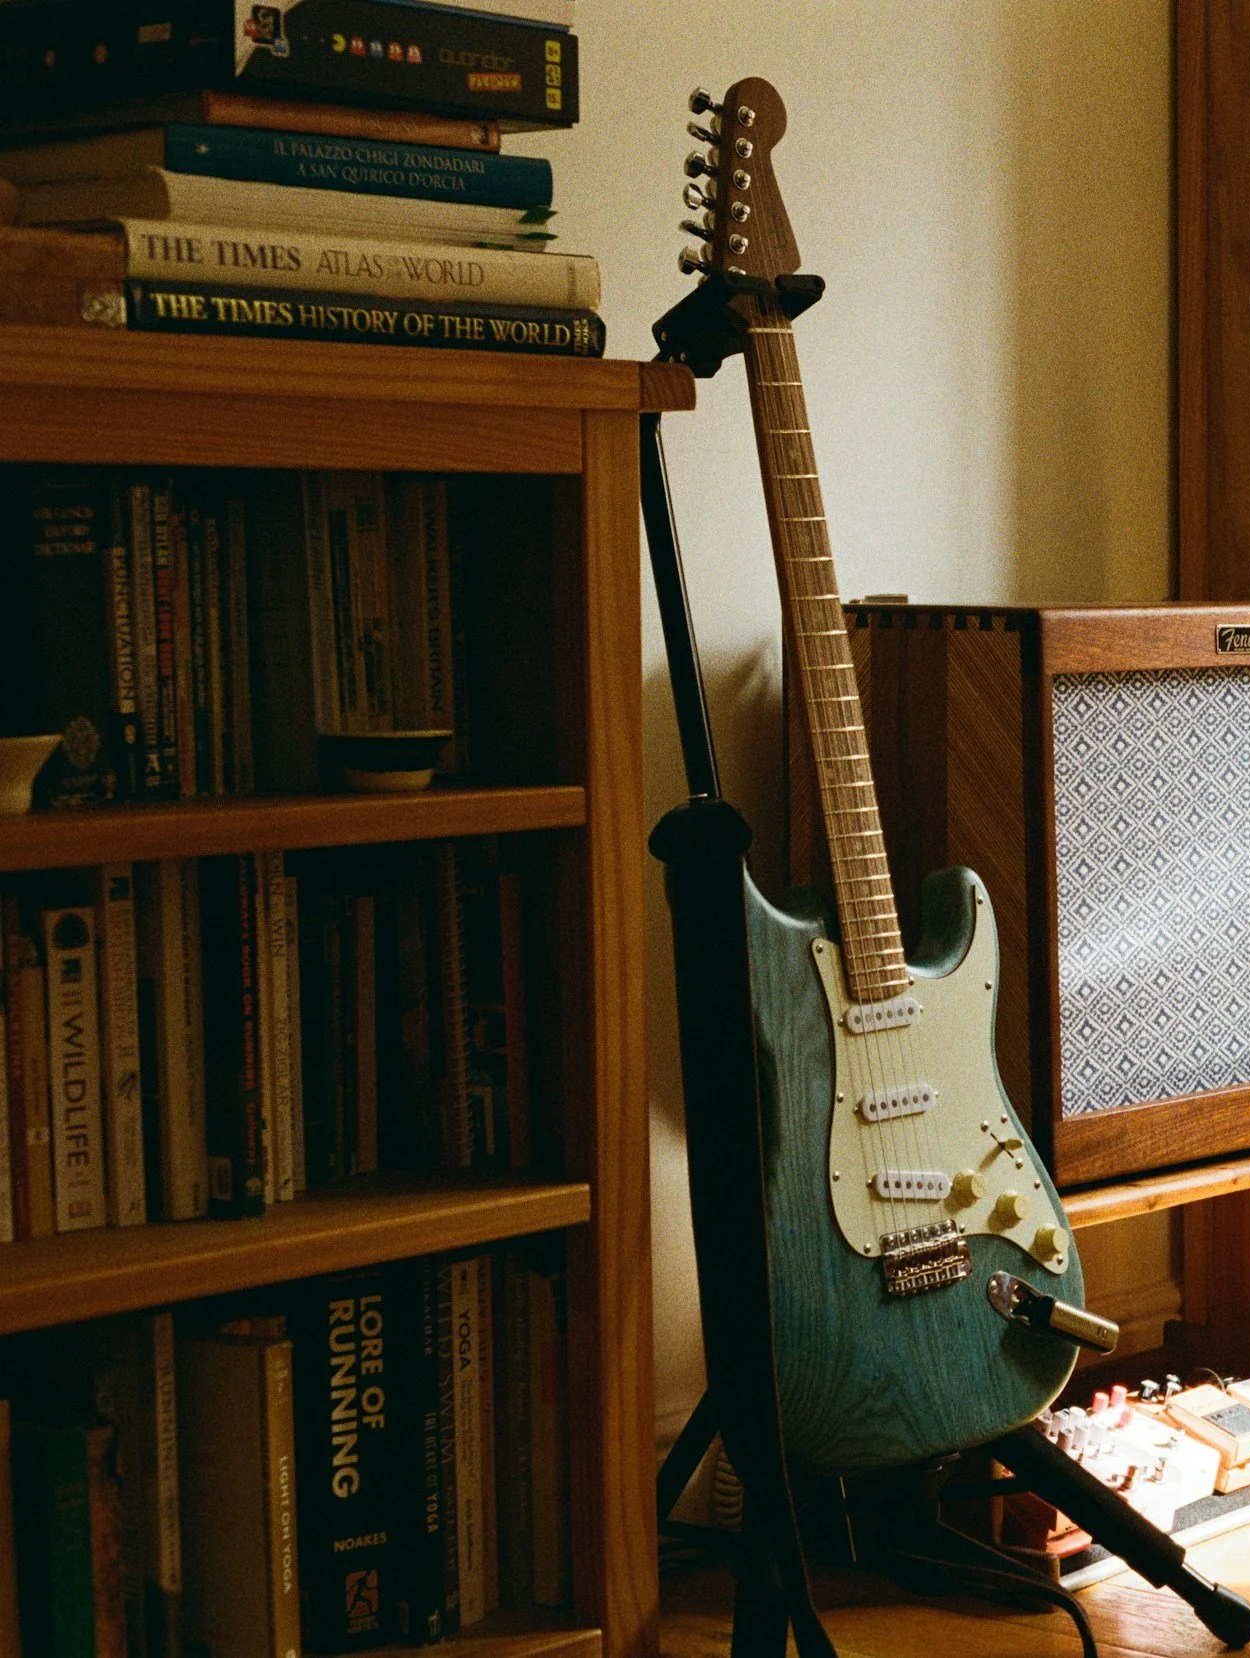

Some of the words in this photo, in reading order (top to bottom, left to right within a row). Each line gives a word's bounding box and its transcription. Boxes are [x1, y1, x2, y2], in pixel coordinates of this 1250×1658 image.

[274, 140, 290, 156] IL
[293, 142, 352, 163] PALAZZO
[354, 147, 400, 167] CHIGI
[403, 151, 486, 175] ZONDADARI
[297, 160, 308, 176] A
[311, 163, 340, 179] SAN
[344, 166, 402, 187] QUIRICO
[408, 172, 466, 192] D'ORCIA
[141, 234, 202, 264] THE
[211, 240, 302, 272] TIMES
[316, 250, 384, 279] ATLAS
[401, 256, 485, 287] WORLD
[150, 292, 209, 321] THE
[210, 296, 295, 326] TIMES
[298, 304, 399, 335] HISTORY
[402, 311, 437, 336] OF
[438, 315, 486, 341] THE
[488, 318, 572, 346] WORLD
[428, 626, 444, 712] BRITAIN
[270, 918, 286, 958] WIN
[243, 944, 255, 988] BOOK
[244, 992, 256, 1017] ON
[245, 1020, 257, 1092] RUNNING
[62, 1012, 90, 1168] WILDLIFE
[359, 1295, 384, 1376] LORE
[437, 1265, 453, 1361] WILD
[457, 1309, 472, 1372] YOGA
[328, 1298, 361, 1500] RUNNING
[361, 1386, 386, 1430] OF
[423, 1411, 438, 1432] THE
[439, 1373, 456, 1465] SWIM
[424, 1434, 439, 1472] HEART
[278, 1455, 290, 1507] LIGHT
[425, 1474, 439, 1489] OF
[281, 1511, 291, 1540] ON
[426, 1492, 441, 1534] YOGA
[333, 1530, 388, 1554] NOAKES
[282, 1543, 293, 1594] YOGA
